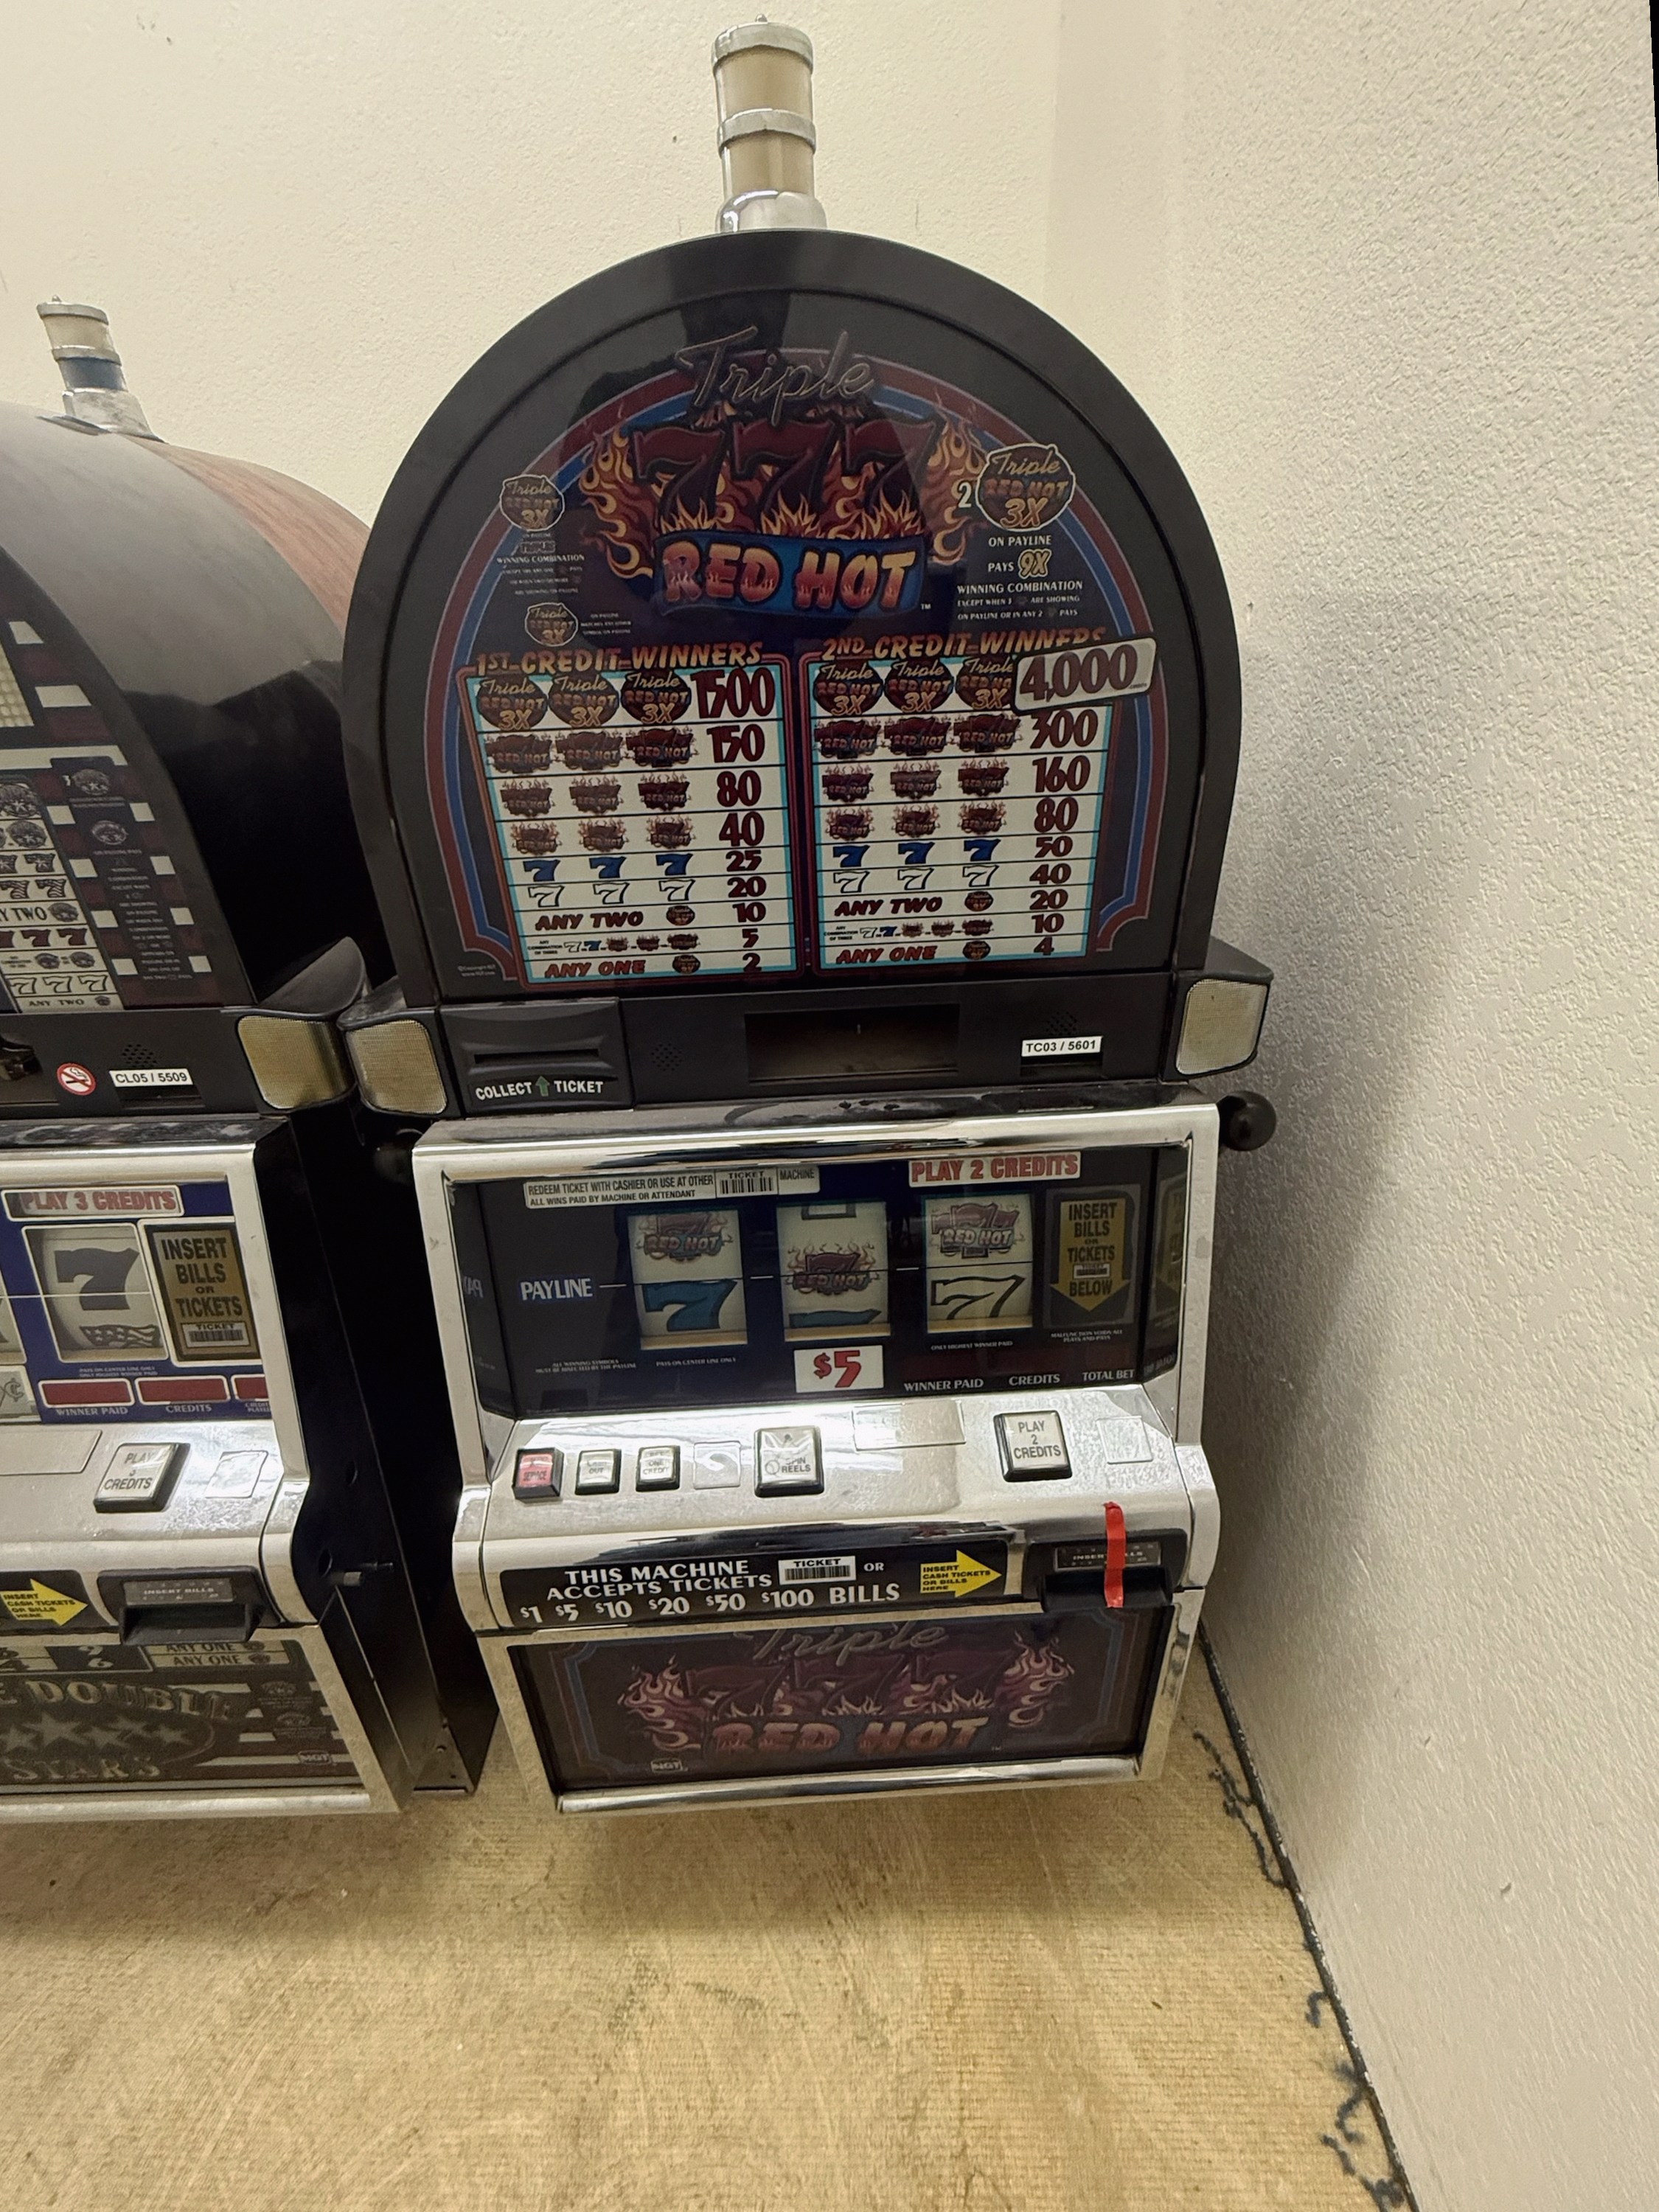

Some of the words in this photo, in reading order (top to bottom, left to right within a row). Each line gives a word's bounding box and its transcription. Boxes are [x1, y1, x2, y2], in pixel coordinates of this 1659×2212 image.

[675, 326, 875, 427] Triple
[992, 450, 1060, 476] Triple
[959, 481, 973, 507] 2
[1027, 481, 1068, 499] HOT
[1001, 497, 1048, 528] 3X
[988, 537, 1004, 547] ON
[1008, 535, 1052, 547] PAYLINE
[988, 562, 1015, 573] PAYS
[1018, 549, 1052, 579] 9X
[664, 540, 780, 602] RED
[794, 549, 916, 611] HOT
[957, 584, 1004, 594] WINNING
[1007, 581, 1083, 593] COMBINATION
[822, 637, 865, 661] 2ND
[874, 632, 972, 659] CREDIT
[477, 652, 511, 675] 1ST
[521, 647, 621, 674] CREDIT
[632, 641, 764, 669] WINNERS
[1019, 644, 1138, 702] 4,000
[690, 667, 776, 719] 1500
[1029, 709, 1098, 749] 300
[706, 723, 765, 763] 150
[1032, 754, 1091, 793] 160
[717, 770, 762, 807] 80
[1034, 796, 1079, 833] 80
[719, 810, 765, 847] 40
[1034, 836, 1074, 859] 50
[726, 850, 762, 872] 25
[1029, 863, 1072, 886] 40
[727, 876, 767, 898] 20
[11, 906, 47, 921] TWO
[834, 900, 884, 917] ANY
[890, 897, 942, 914] TWO
[1029, 888, 1068, 911] 20
[535, 913, 583, 931] ANY
[590, 911, 644, 928] TWO
[732, 902, 767, 922] 10
[1031, 913, 1065, 933] 10
[742, 928, 759, 949] 5
[835, 947, 884, 964] ANY
[888, 945, 938, 962] ONE
[1033, 936, 1055, 956] 4
[544, 961, 591, 978] ANY
[599, 959, 646, 976] ONE
[743, 952, 762, 973] 2
[1025, 1041, 1057, 1054] TC03
[1068, 1039, 1097, 1052] 5601
[115, 1073, 149, 1084] CL05
[157, 1071, 188, 1082] 5509
[475, 1081, 532, 1100] COLLECT
[554, 1080, 604, 1095] TICKET
[911, 1160, 964, 1182] PLAY
[970, 1160, 984, 1180] 2
[990, 1155, 1079, 1179] CREDITS
[528, 1182, 560, 1195] REDEEM
[562, 1181, 589, 1194] TICKET
[590, 1180, 611, 1192] WITH
[613, 1179, 646, 1191] CASHIER
[648, 1178, 658, 1189] OR
[660, 1178, 675, 1189] USE
[677, 1176, 687, 1186] AT
[689, 1175, 713, 1186] OTHER
[728, 1171, 764, 1179] TICKET
[779, 1169, 815, 1180] MACHINE
[21, 1192, 69, 1211] PLAY
[75, 1192, 88, 1211] 3
[92, 1190, 176, 1211] CREDITS
[530, 1198, 544, 1206] ALL
[546, 1197, 568, 1206] WINS
[568, 1196, 587, 1204] PAID
[601, 1192, 636, 1203] MACHINE
[639, 1192, 650, 1200] OR
[652, 1189, 695, 1200] ATTENDANT
[1069, 1201, 1118, 1221] INSERT
[978, 1228, 1012, 1245] HOT
[1074, 1220, 1110, 1238] BILLS
[161, 1237, 228, 1261] INSERT
[644, 1234, 681, 1252] RED
[684, 1233, 720, 1251] HOT
[1068, 1245, 1116, 1262] TICKETS
[54, 1247, 141, 1311] 7
[175, 1262, 226, 1284] BILLS
[521, 1278, 593, 1301] PAYLINE
[1069, 1279, 1113, 1298] BELOW
[174, 1295, 243, 1318] TICKETS
[642, 1281, 738, 1333] 7
[195, 1323, 235, 1331] TICKET
[813, 1349, 862, 1389] $5
[1082, 1371, 1114, 1382] TOTAL
[1116, 1368, 1135, 1380] BET
[903, 1380, 951, 1392] WINNER
[953, 1378, 984, 1390] PAID
[1008, 1374, 1061, 1387] CREDITS
[56, 1407, 99, 1416] WINNER
[101, 1406, 128, 1415] PAID
[165, 1403, 213, 1413] CREDITS
[1018, 1420, 1046, 1434] PLAY
[1030, 1433, 1038, 1445] 2
[1013, 1444, 1062, 1460] CREDITS
[590, 1467, 605, 1475] OUT
[643, 1467, 670, 1475] CREDIT
[782, 1464, 811, 1473] REELS
[104, 1477, 153, 1490] CREDITS
[546, 1581, 662, 1601] ACCEPTS
[669, 1573, 773, 1593] TICKETS
[793, 1558, 841, 1568] TICKET
[863, 1562, 885, 1573] OR
[564, 1568, 623, 1585] THIS
[630, 1559, 750, 1581] MACHINE
[922, 1565, 959, 1573] INSERT
[520, 1606, 543, 1624] $1
[555, 1604, 579, 1621] $5
[595, 1599, 633, 1619] $10
[649, 1596, 691, 1615] $20
[706, 1593, 746, 1613] $50
[761, 1588, 815, 1608] $100
[830, 1582, 901, 1604] BILLS
[174, 1656, 211, 1666] ANY
[214, 1655, 243, 1665] ONE
[712, 1722, 841, 1753] RED
[858, 1717, 990, 1753] HOT
